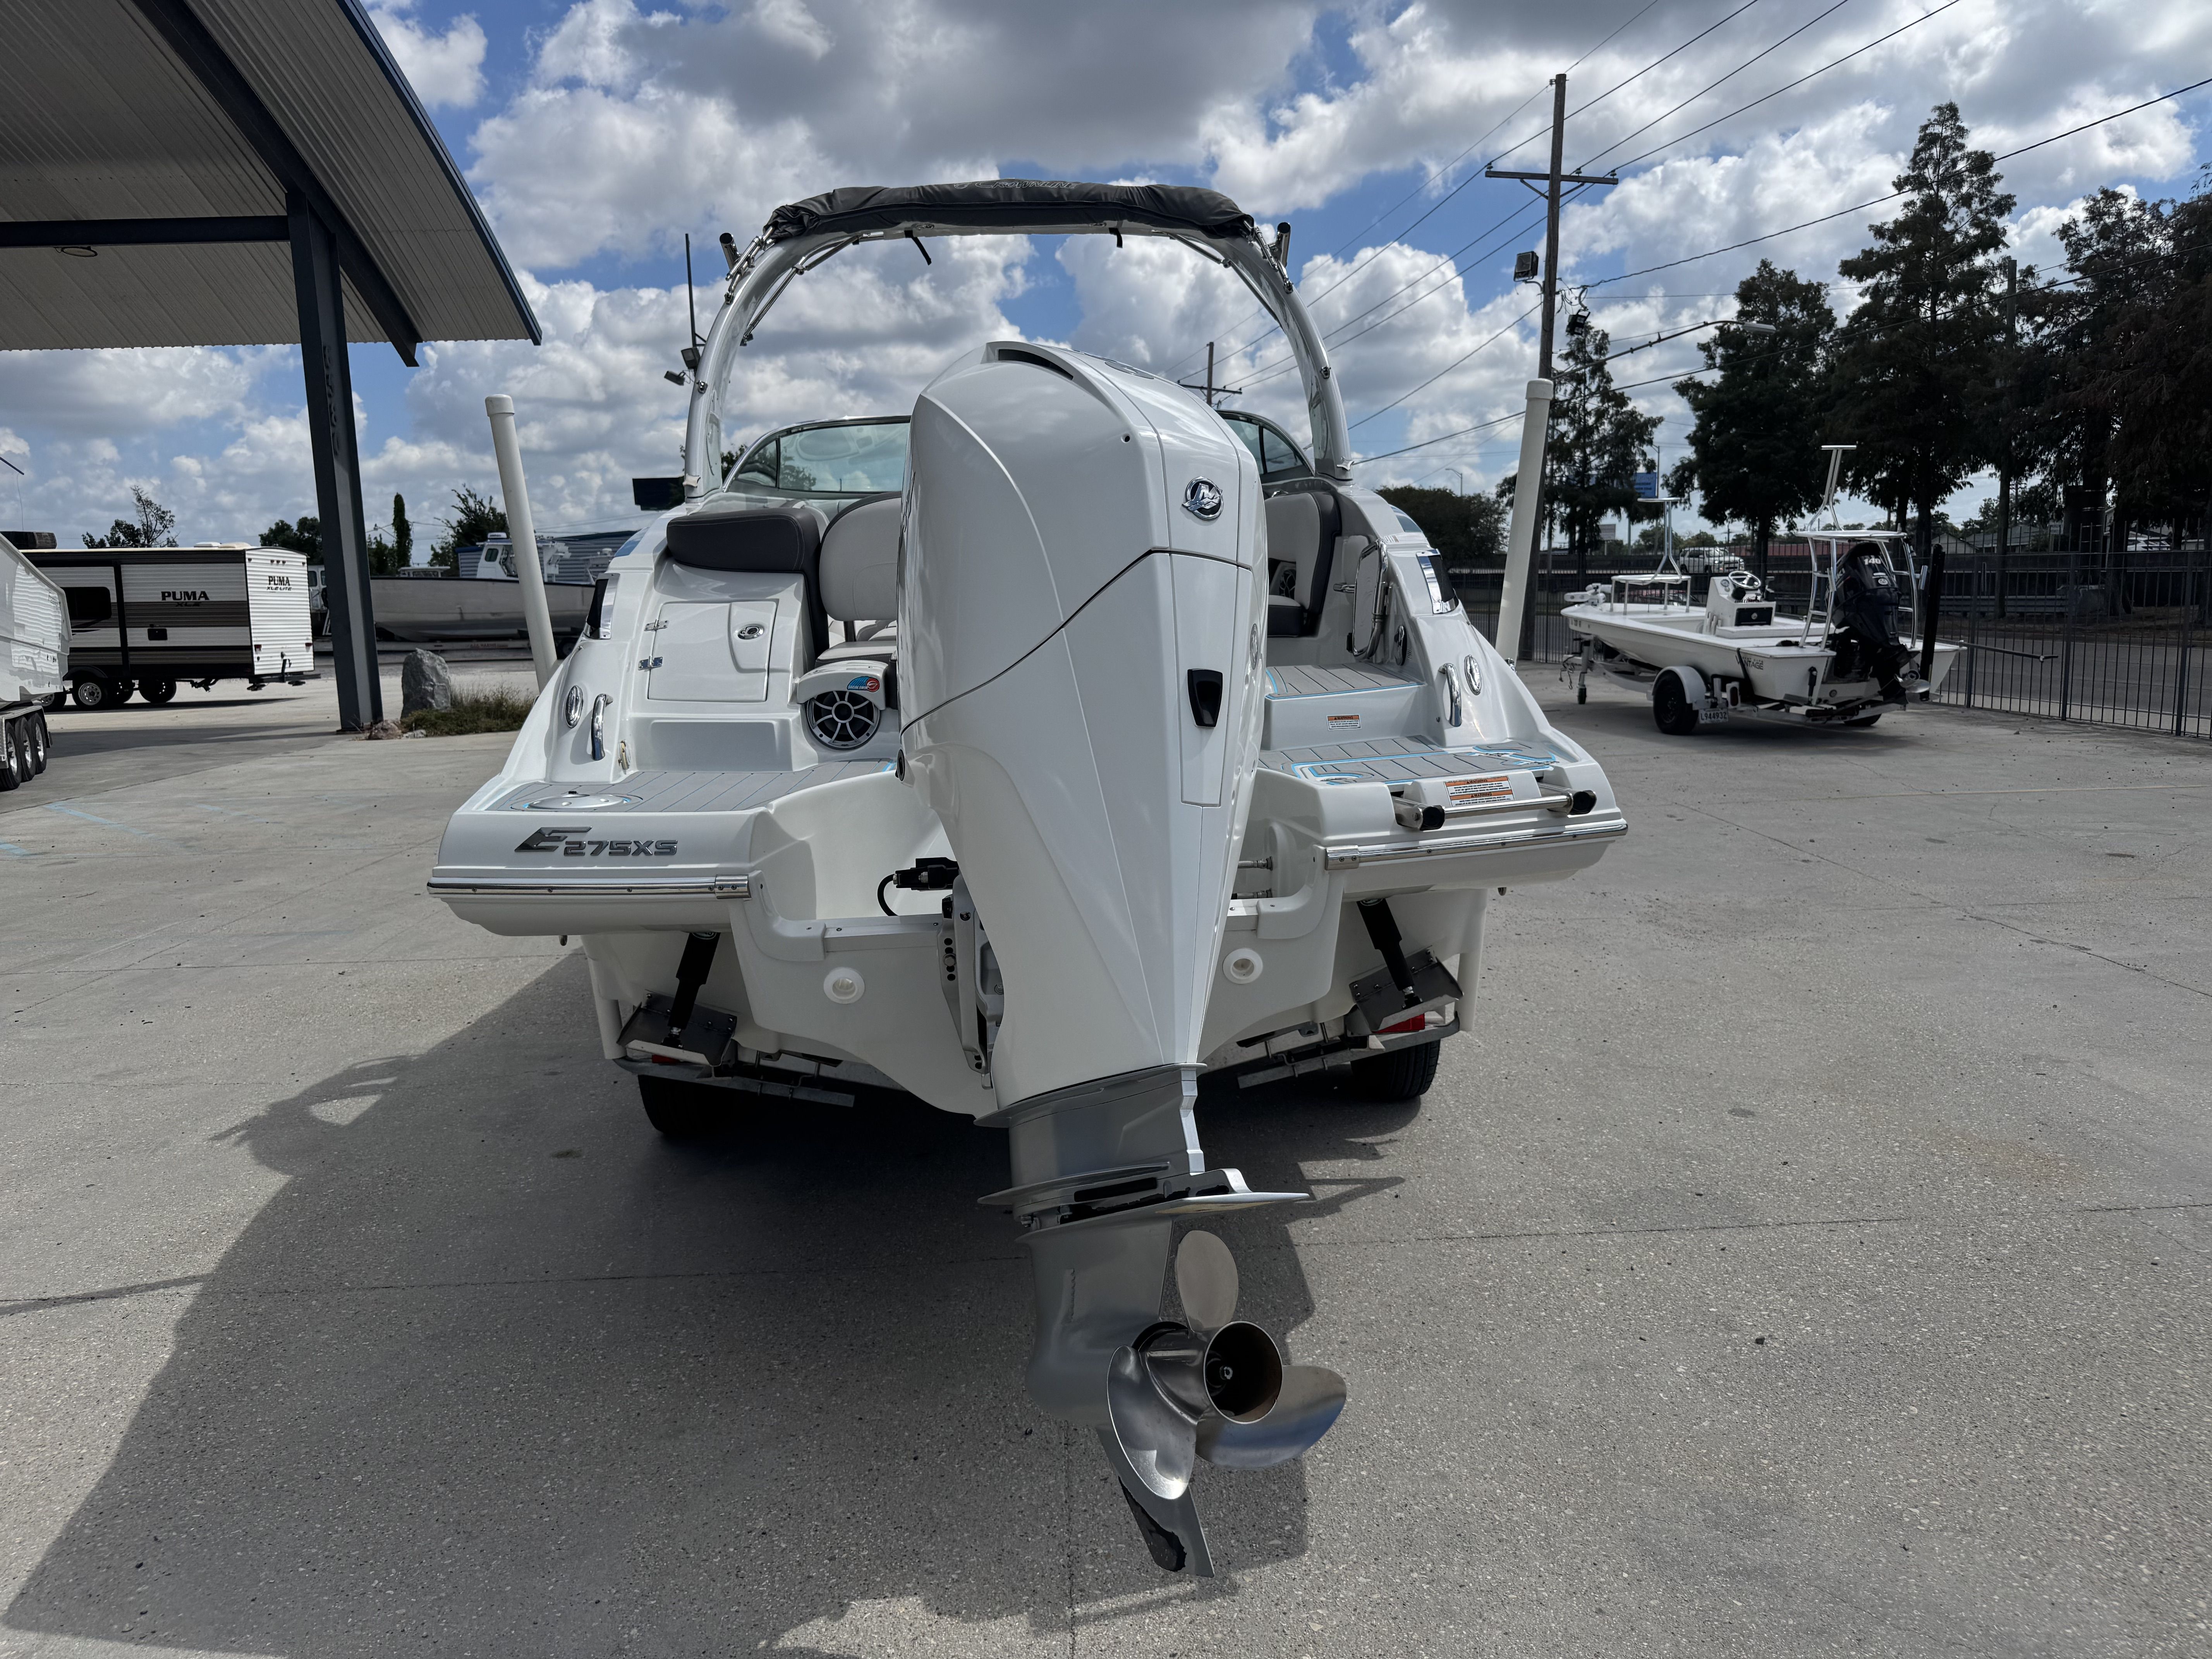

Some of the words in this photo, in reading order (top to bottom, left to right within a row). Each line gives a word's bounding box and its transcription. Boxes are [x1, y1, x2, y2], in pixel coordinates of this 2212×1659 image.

[1864, 555, 1881, 565] 140
[268, 576, 290, 586] PUMA
[161, 591, 210, 601] PUMA
[1735, 655, 1764, 670] VNTAGE
[1700, 712, 1727, 720] L944932
